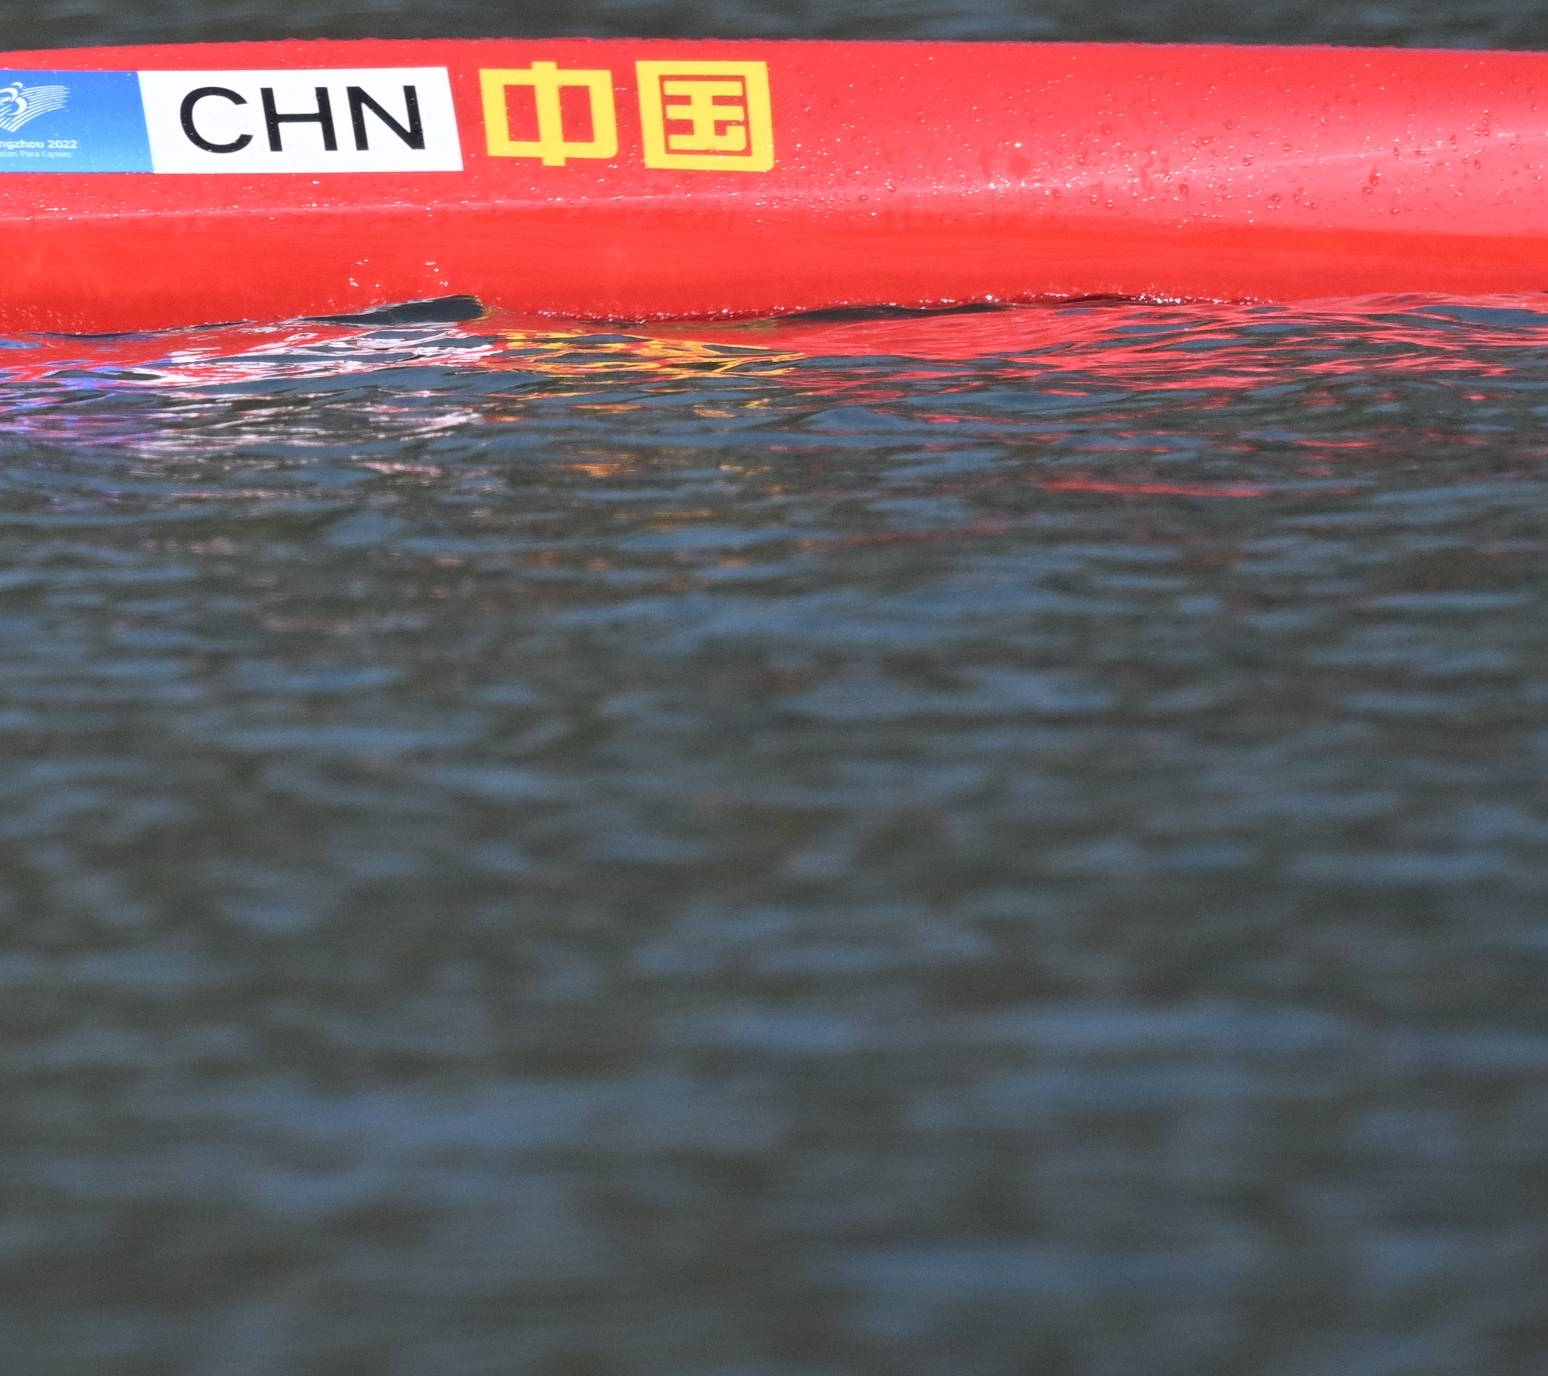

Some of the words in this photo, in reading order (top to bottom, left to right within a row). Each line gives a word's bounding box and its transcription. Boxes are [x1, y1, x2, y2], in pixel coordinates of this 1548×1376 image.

[47, 139, 78, 149] 2022
[179, 84, 426, 154] CHN
[479, 61, 775, 173] 中国
